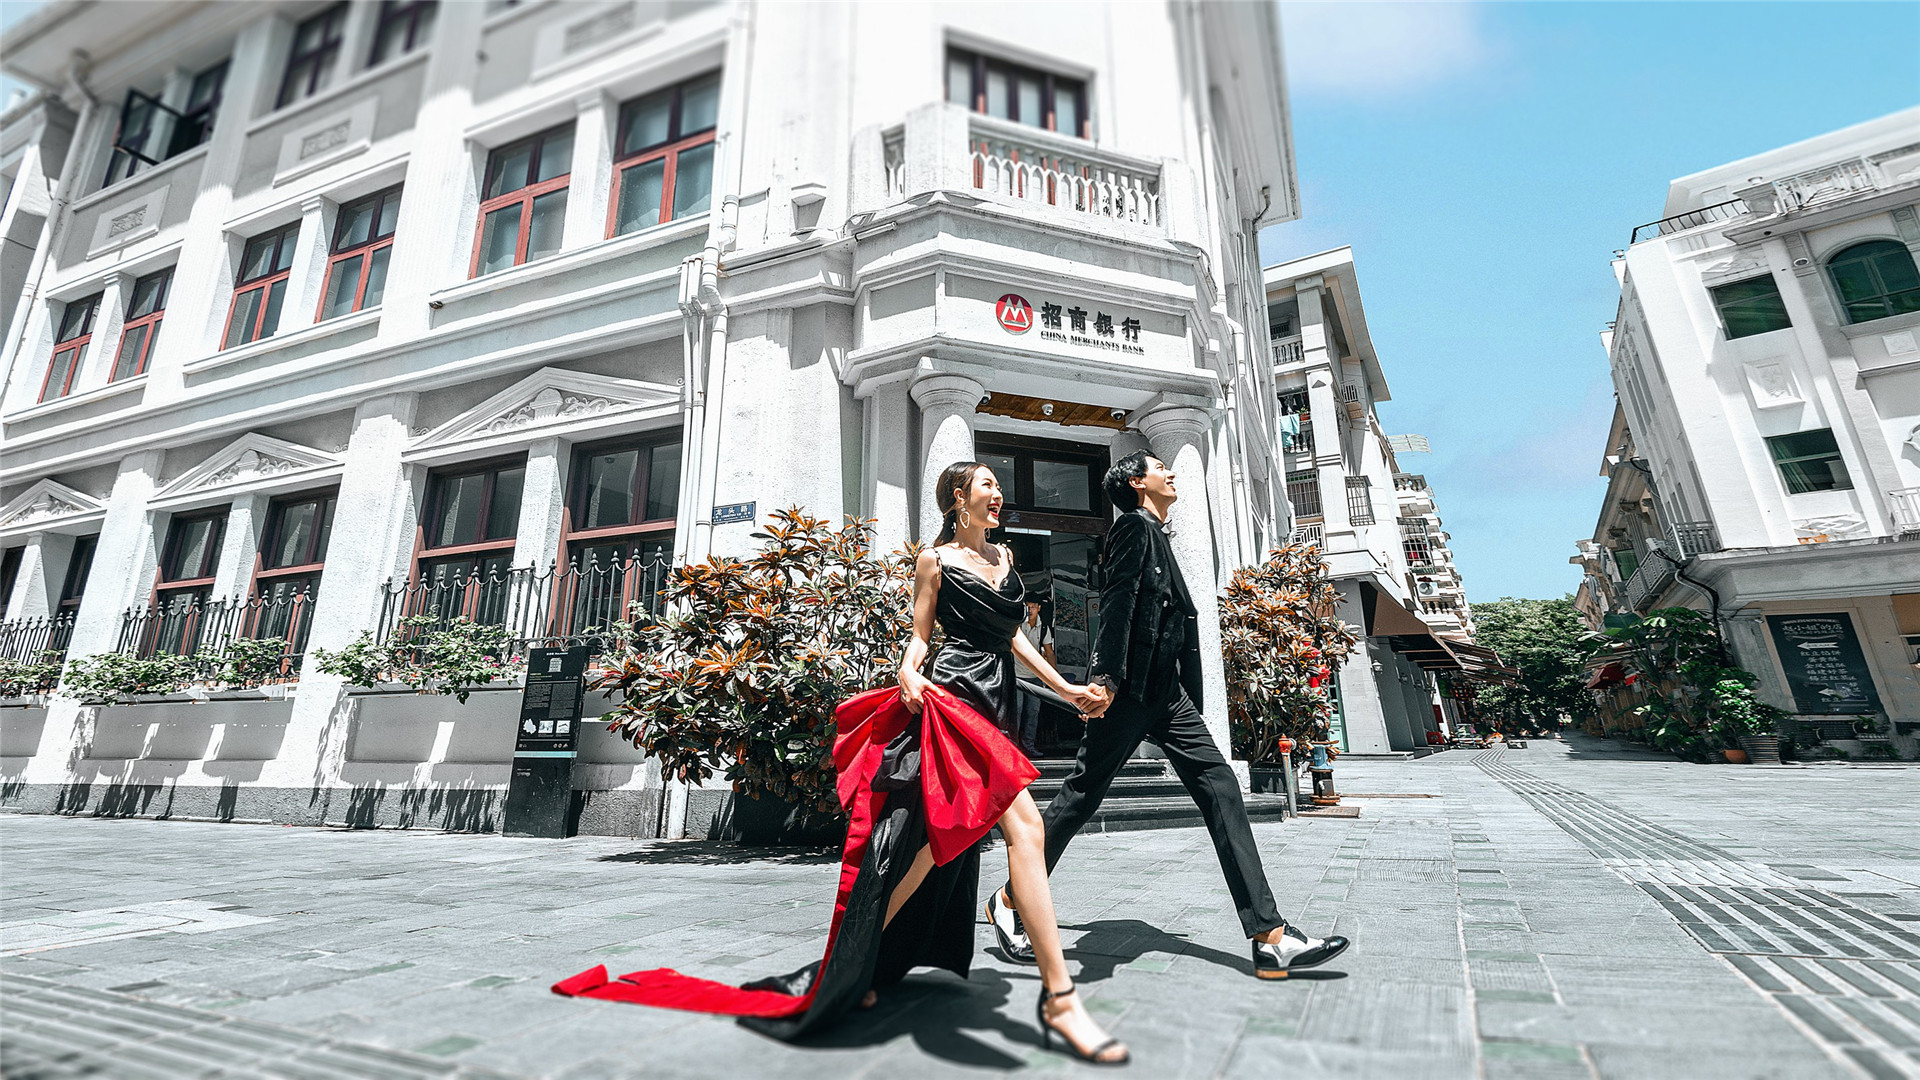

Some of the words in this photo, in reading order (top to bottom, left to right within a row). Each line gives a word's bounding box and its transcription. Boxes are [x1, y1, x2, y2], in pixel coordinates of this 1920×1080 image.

[1041, 301, 1141, 342] 招商银行
[1041, 331, 1067, 340] CHINA
[1070, 335, 1120, 349] MERCHANTS
[1122, 344, 1145, 353] BANK
